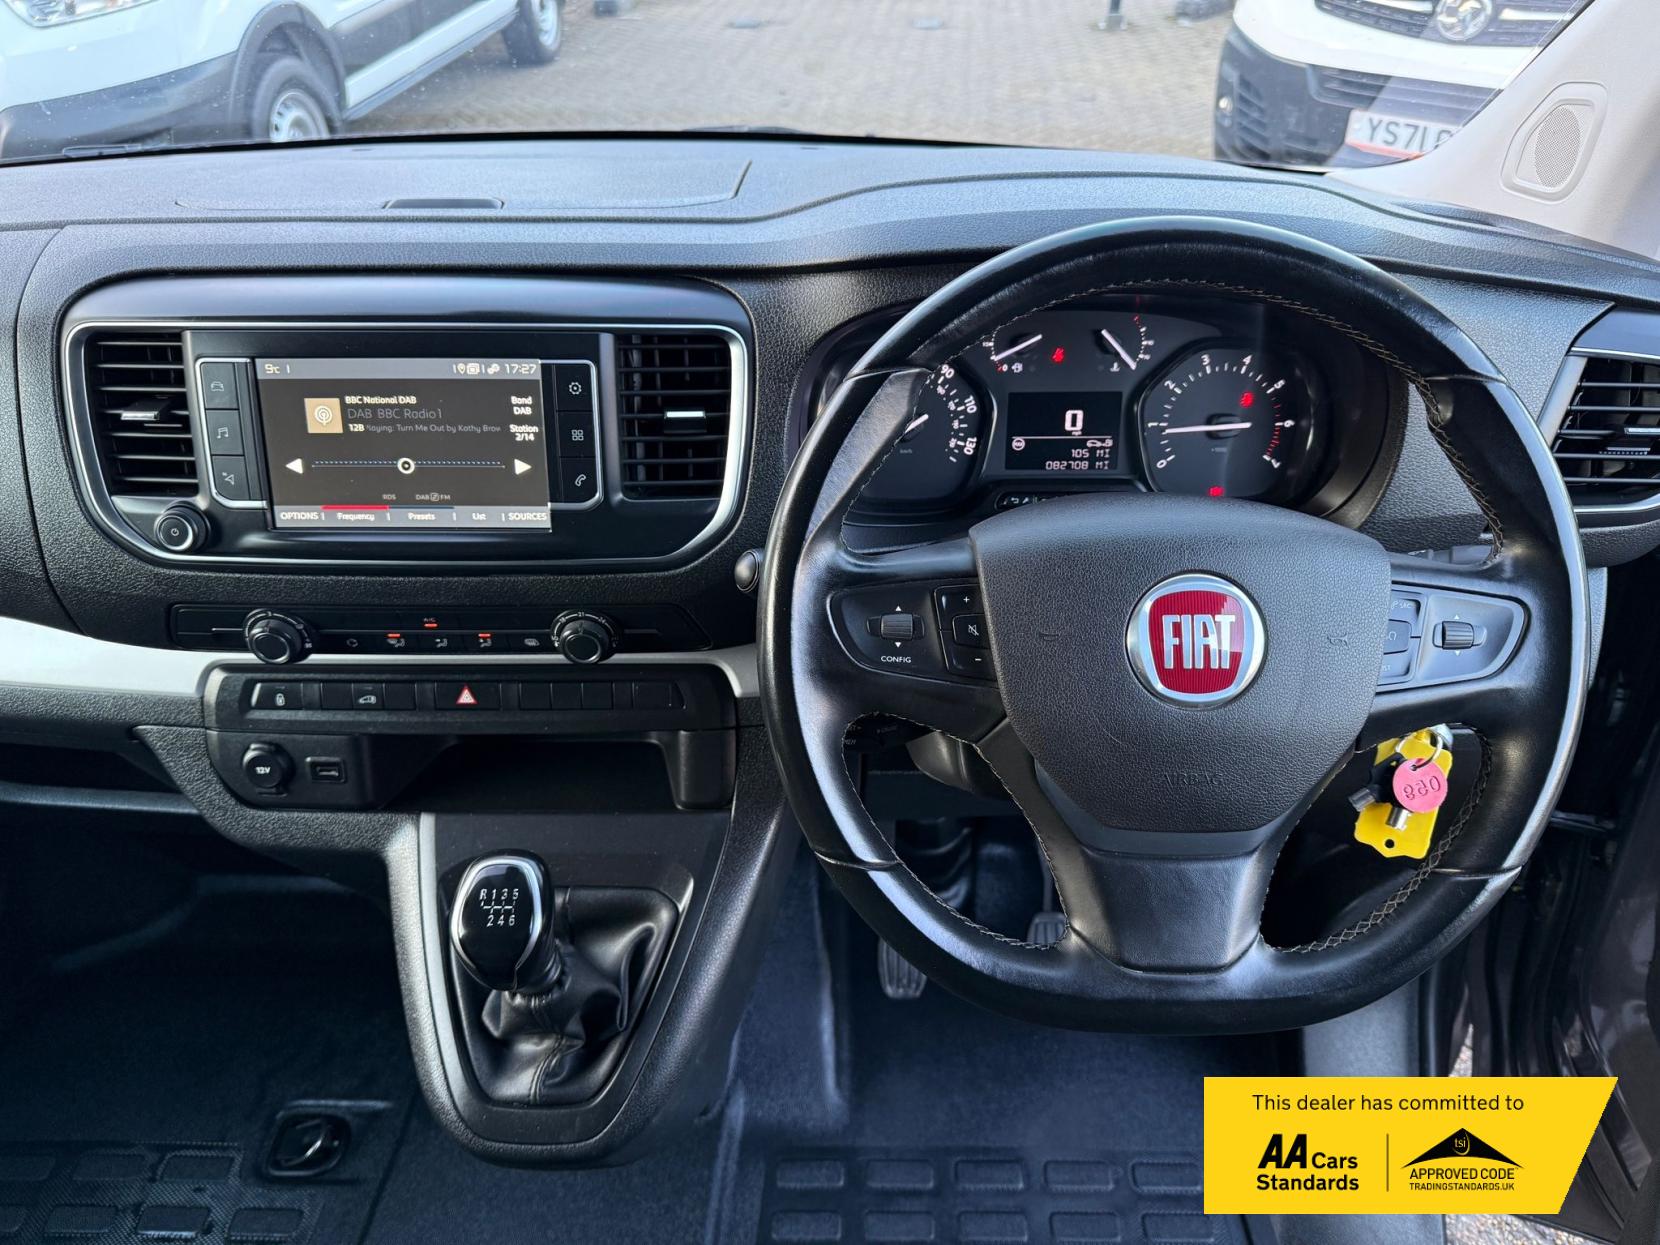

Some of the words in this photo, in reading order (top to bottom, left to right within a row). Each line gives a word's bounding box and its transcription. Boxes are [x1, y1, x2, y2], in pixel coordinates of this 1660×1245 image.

[1201, 354, 1211, 366] 3
[1242, 354, 1253, 365] 4
[504, 363, 537, 374] 17:27
[941, 364, 955, 379] 90
[1164, 380, 1176, 390] 2
[1273, 379, 1285, 389] 5
[345, 395, 362, 404] BBC
[363, 395, 398, 404] National
[398, 395, 417, 404] DAB
[510, 395, 533, 405] Band
[964, 395, 978, 414] 110
[347, 408, 373, 419] DAB
[377, 408, 401, 419] BBC
[513, 406, 532, 415] DAB
[1064, 410, 1084, 431] 0
[1283, 419, 1295, 428] 6
[348, 423, 365, 432] 12B
[396, 423, 414, 432] Turn
[415, 424, 428, 432] Me
[429, 423, 445, 432] Out
[446, 423, 457, 434] by
[509, 424, 539, 433] Station
[515, 432, 535, 441] 2/14
[963, 437, 977, 455] 130
[1071, 448, 1090, 459] 105
[1096, 448, 1111, 459] MI
[1045, 460, 1089, 471] 082708
[1095, 460, 1110, 471] MI
[1156, 457, 1168, 469] 0
[1271, 457, 1282, 469] 7
[280, 511, 319, 520] OPTIONS
[336, 512, 375, 522] Frequency
[508, 511, 547, 521] SOURCES
[1162, 613, 1236, 670] FIAT
[880, 655, 912, 664] CONFIG
[255, 766, 271, 775] 12V
[479, 888, 487, 900] R
[491, 888, 497, 900] 1
[501, 888, 509, 900] 3
[512, 888, 519, 900] 5
[486, 914, 494, 927] 2
[497, 914, 505, 926] 4
[508, 914, 515, 926] 6
